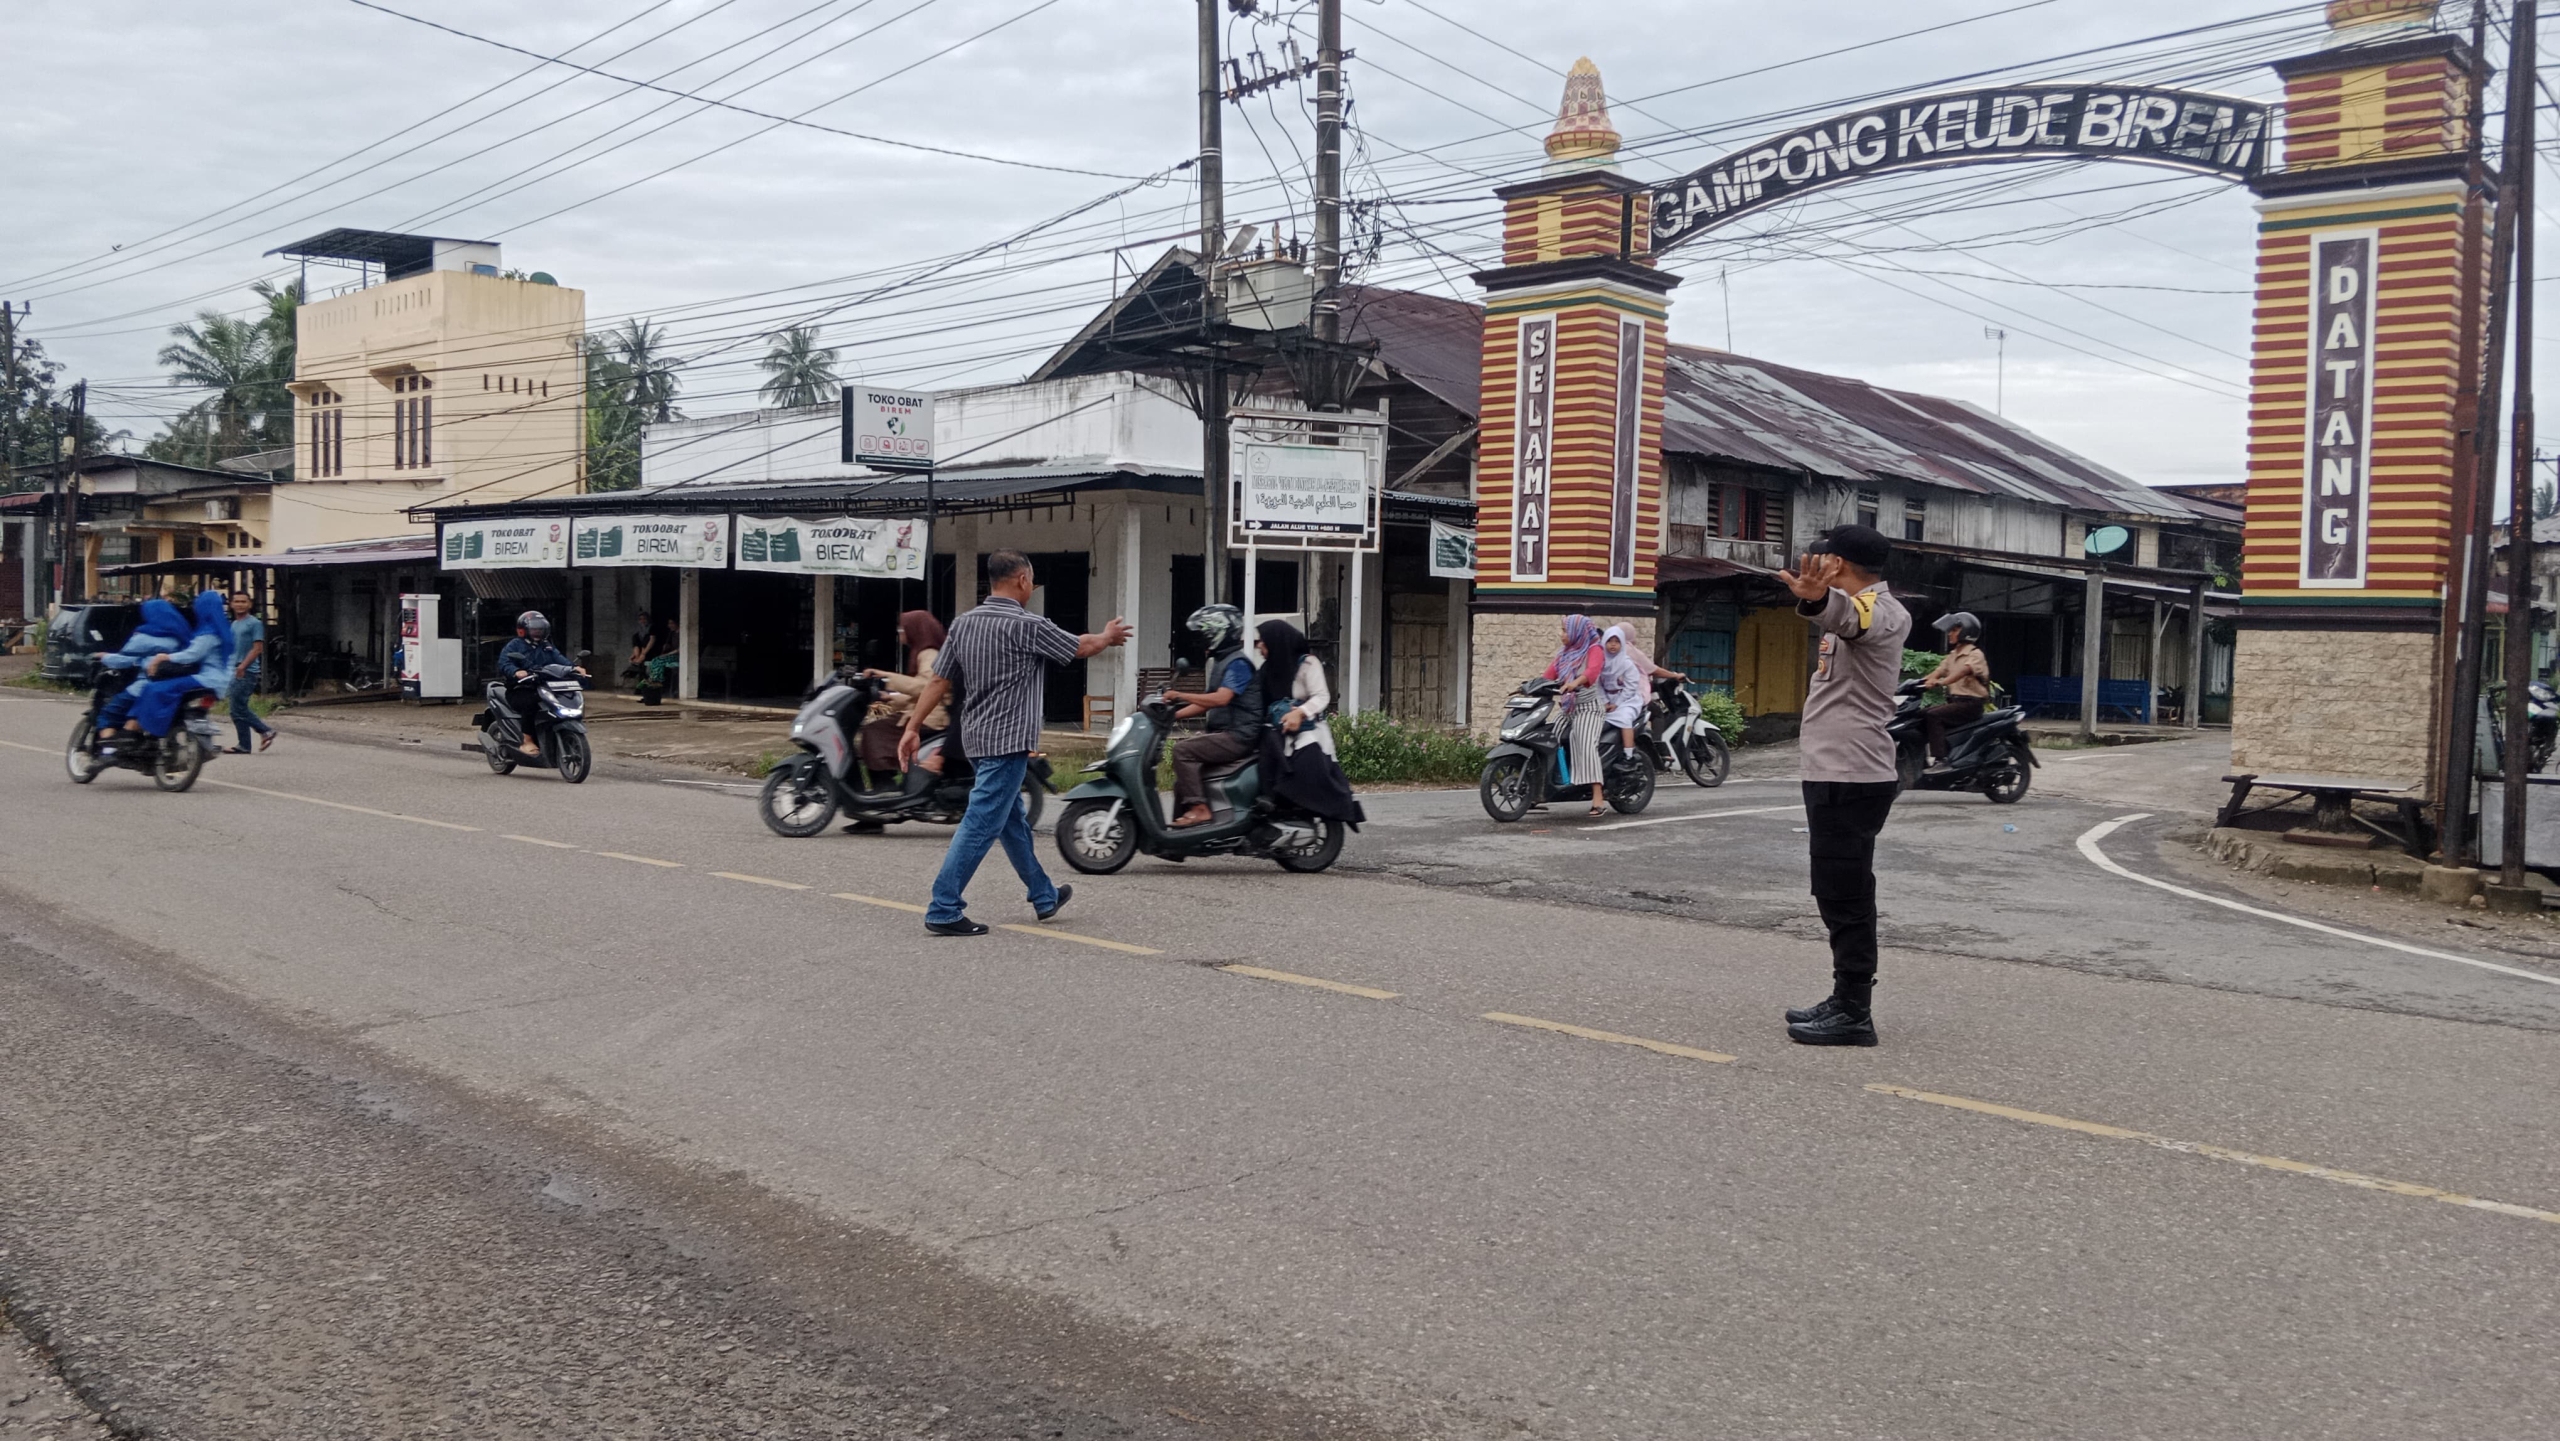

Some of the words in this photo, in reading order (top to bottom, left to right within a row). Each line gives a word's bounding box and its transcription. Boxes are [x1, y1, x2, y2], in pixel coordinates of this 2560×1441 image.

[1652, 116, 1887, 239] GAMPONG
[1897, 93, 2074, 158] KEUDE
[2077, 92, 2267, 168] BIREM
[868, 393, 895, 405] TOKO
[897, 396, 924, 408] OBAT
[2321, 265, 2360, 546] DATANG
[880, 405, 912, 415] BIREM
[1521, 327, 1547, 564] SELAMAT
[491, 529, 512, 538] TOKO
[632, 524, 659, 534] TOKO
[494, 541, 529, 555] BIREM
[637, 538, 679, 554] BIREM
